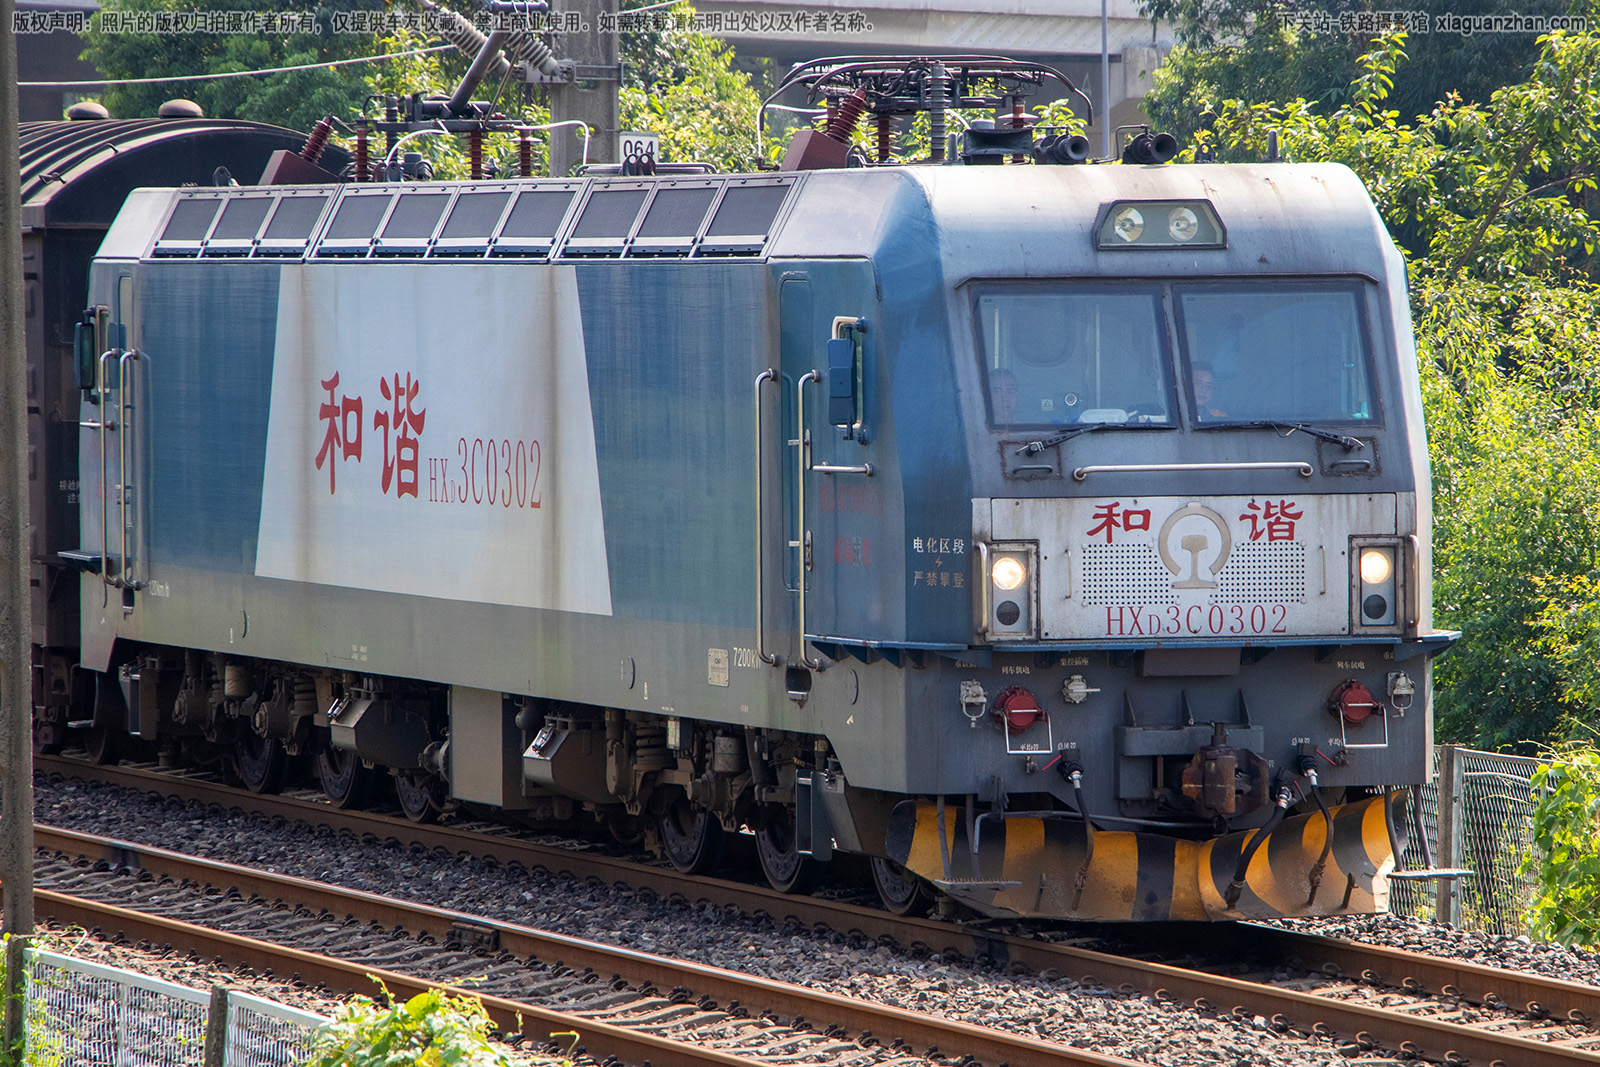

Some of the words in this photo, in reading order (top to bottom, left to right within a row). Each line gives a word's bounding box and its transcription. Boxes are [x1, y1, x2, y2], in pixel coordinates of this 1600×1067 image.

[623, 139, 655, 158] 064
[315, 370, 426, 499] 和谐
[428, 437, 541, 509] HXD3C0302
[913, 537, 965, 555] 电化区段
[913, 571, 964, 588] 严禁攀登
[1105, 604, 1288, 636] HXD3C0302
